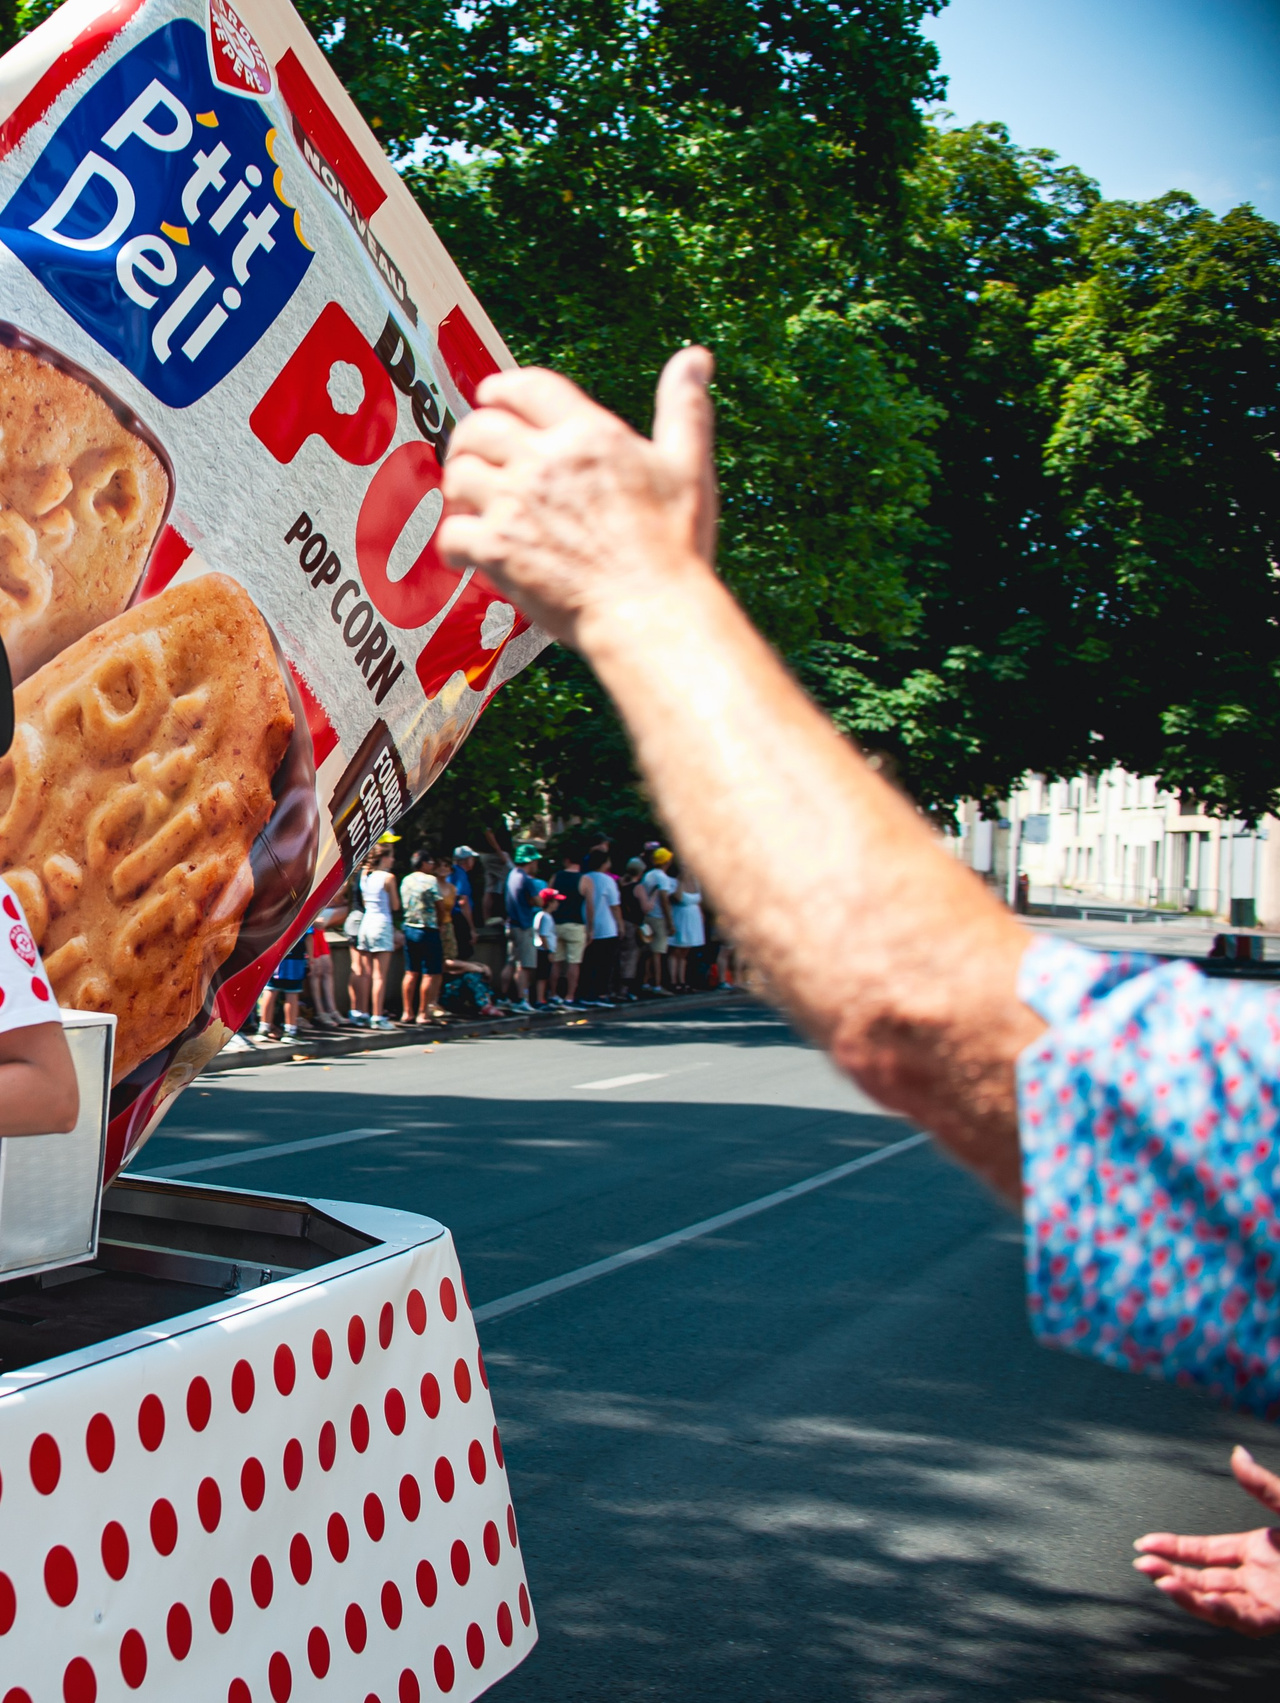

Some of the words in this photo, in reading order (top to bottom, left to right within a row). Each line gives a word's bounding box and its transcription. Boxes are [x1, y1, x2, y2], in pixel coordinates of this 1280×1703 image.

[27, 149, 242, 365] Déli
[303, 138, 405, 302] NOUVEAU
[284, 511, 342, 589] POP
[330, 579, 406, 707] CORN
[346, 809, 366, 847] AU
